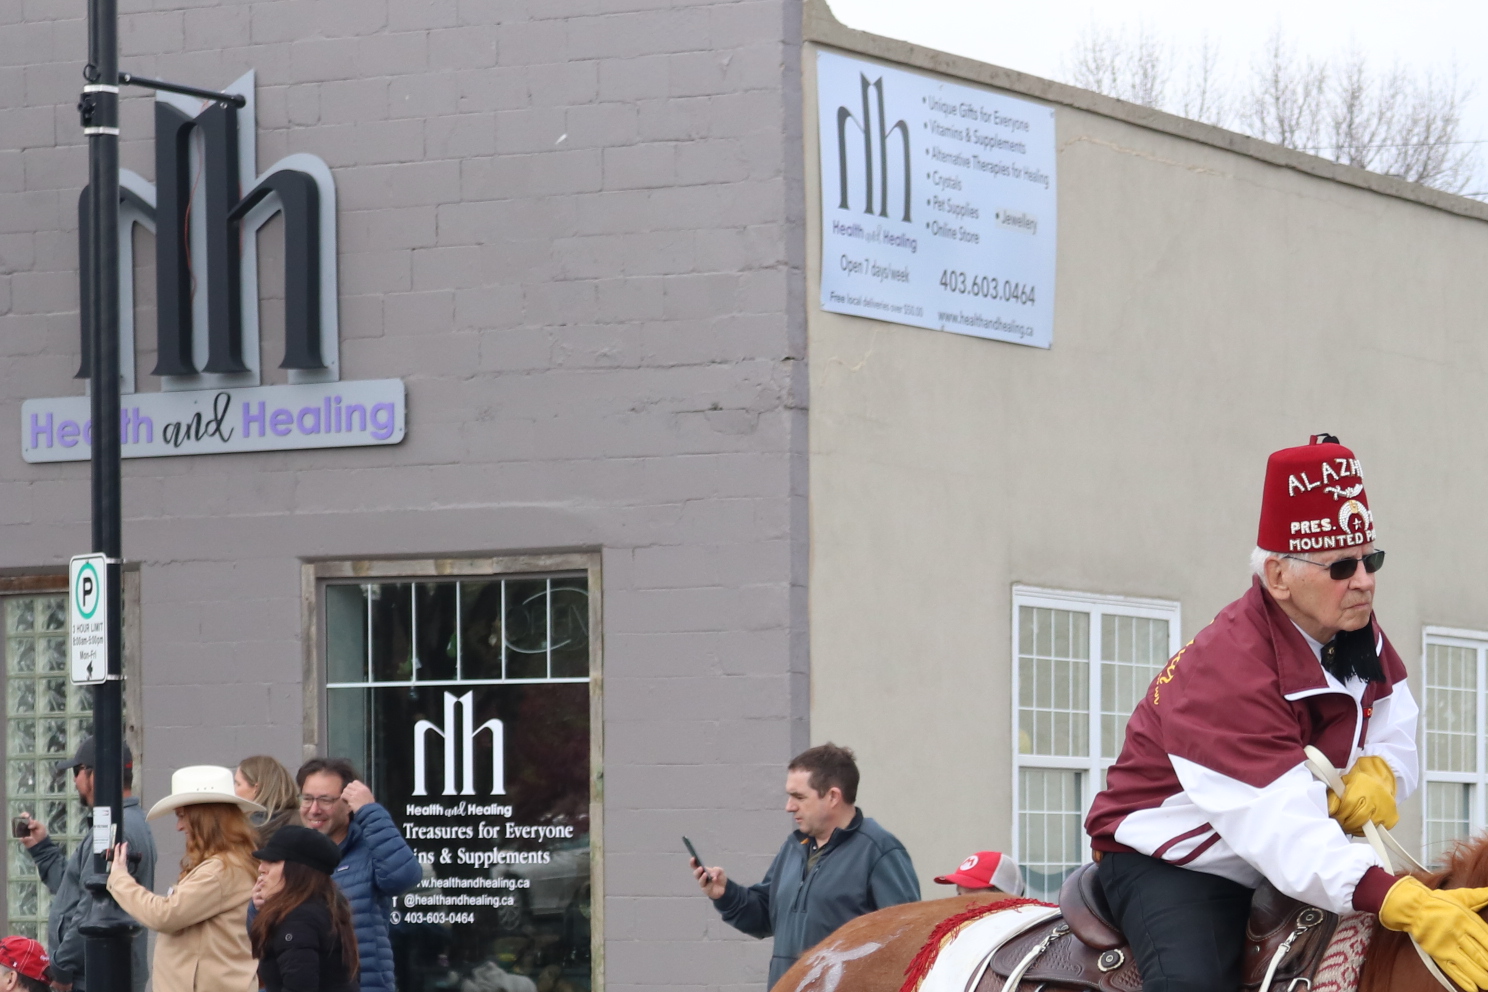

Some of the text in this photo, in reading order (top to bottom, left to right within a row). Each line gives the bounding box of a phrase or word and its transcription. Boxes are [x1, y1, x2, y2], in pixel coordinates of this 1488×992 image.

[928, 95, 1030, 133] Unique Gifts for Everyone
[929, 119, 1027, 155] Vitamins & Supplements
[932, 146, 1050, 190] Alternative Therapies for Healing
[932, 170, 962, 192] Crystals
[933, 195, 979, 220] Pet Supplies
[931, 220, 980, 245] Online Store
[1002, 209, 1037, 235] Jewellery
[833, 219, 864, 240] Health
[882, 229, 918, 254] Healing
[840, 254, 910, 283] Open 7 days/week
[830, 291, 845, 304] Free
[847, 293, 861, 306] local
[940, 269, 1036, 306] 403.603.0464
[937, 310, 1034, 339] www.healthandhealing.ca
[29, 391, 395, 450] Heth and Healing
[1288, 472, 1321, 497] AL
[1290, 518, 1337, 535] PRES.
[1289, 532, 1364, 551] MOUNTED
[76, 623, 90, 633] HOUR
[91, 622, 103, 632] LIMIT
[79, 649, 97, 660] Mon-Fri
[406, 801, 513, 818] Health and Healing
[403, 821, 574, 842] Treasures for Everyone
[440, 847, 452, 864] &
[457, 848, 550, 868] Supplements
[417, 877, 530, 890] w.healthandhealing.ca
[404, 894, 515, 908] @healthandhealing.ca
[404, 912, 474, 924] 403-603-0464
